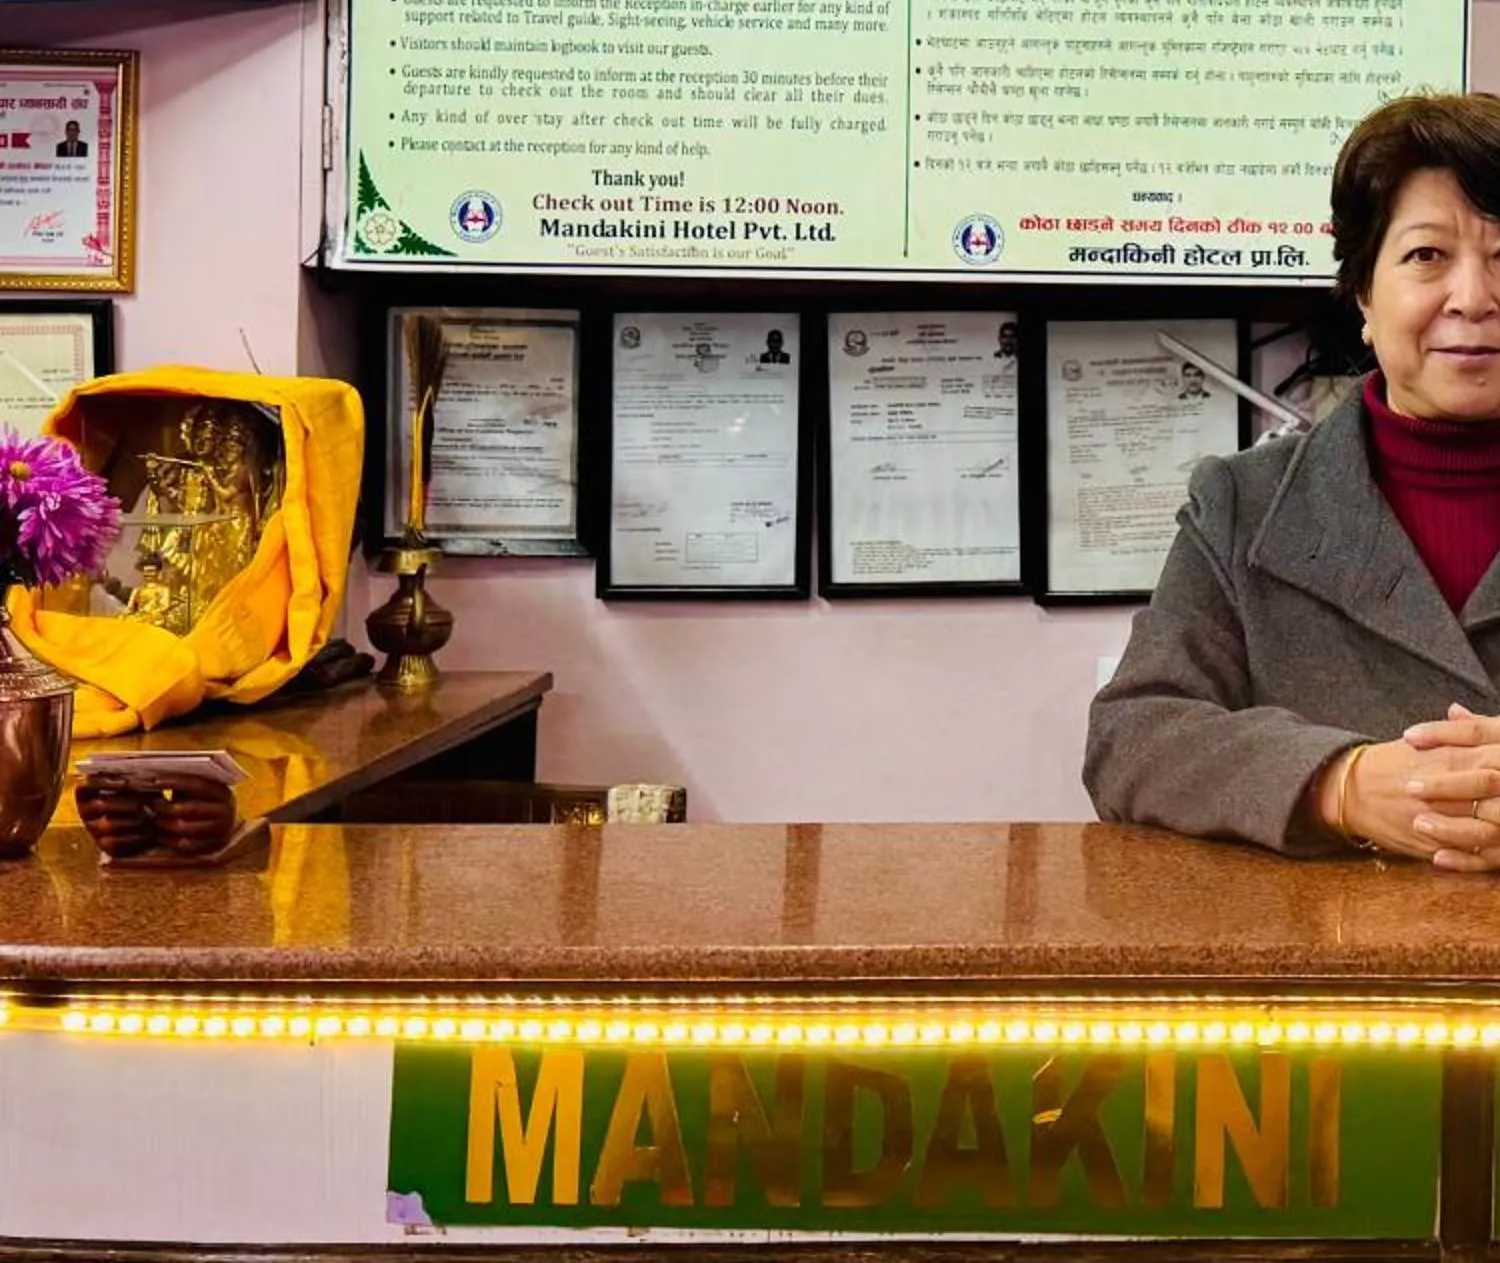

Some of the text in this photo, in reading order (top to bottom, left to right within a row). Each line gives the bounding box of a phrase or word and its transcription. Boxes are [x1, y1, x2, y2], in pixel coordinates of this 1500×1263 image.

[404, 81, 471, 97] departure
[479, 83, 492, 96] to
[501, 83, 541, 97] check
[549, 85, 572, 98] out
[581, 84, 603, 98] the
[612, 87, 649, 99] room
[657, 88, 682, 100] and
[691, 88, 735, 101] should
[744, 88, 776, 102] clear
[785, 88, 803, 102] all
[811, 89, 844, 102] their
[401, 110, 427, 125] Any
[435, 110, 466, 123] kind
[475, 112, 489, 123] of
[497, 114, 528, 124] over
[572, 112, 605, 126] after
[613, 113, 653, 127] check
[661, 116, 684, 128] out
[693, 116, 723, 128] time
[732, 116, 757, 129] will
[766, 116, 782, 129] be
[790, 116, 821, 133] fully
[591, 169, 685, 191] Thank you!
[533, 193, 844, 215] Check out Time is 12:00 Noon.
[540, 218, 836, 242] Mandakini Hotel Pvt. Ltd.
[1020, 214, 1059, 231] कोठा
[1120, 219, 1162, 232] समय
[1168, 216, 1220, 233] दिनको
[1227, 218, 1262, 233] ठीक
[727, 249, 750, 258] our
[1069, 242, 1175, 264] मन्दाकिनी
[1183, 244, 1241, 266] होटल
[465, 1047, 1340, 1208] MANDAKINI
